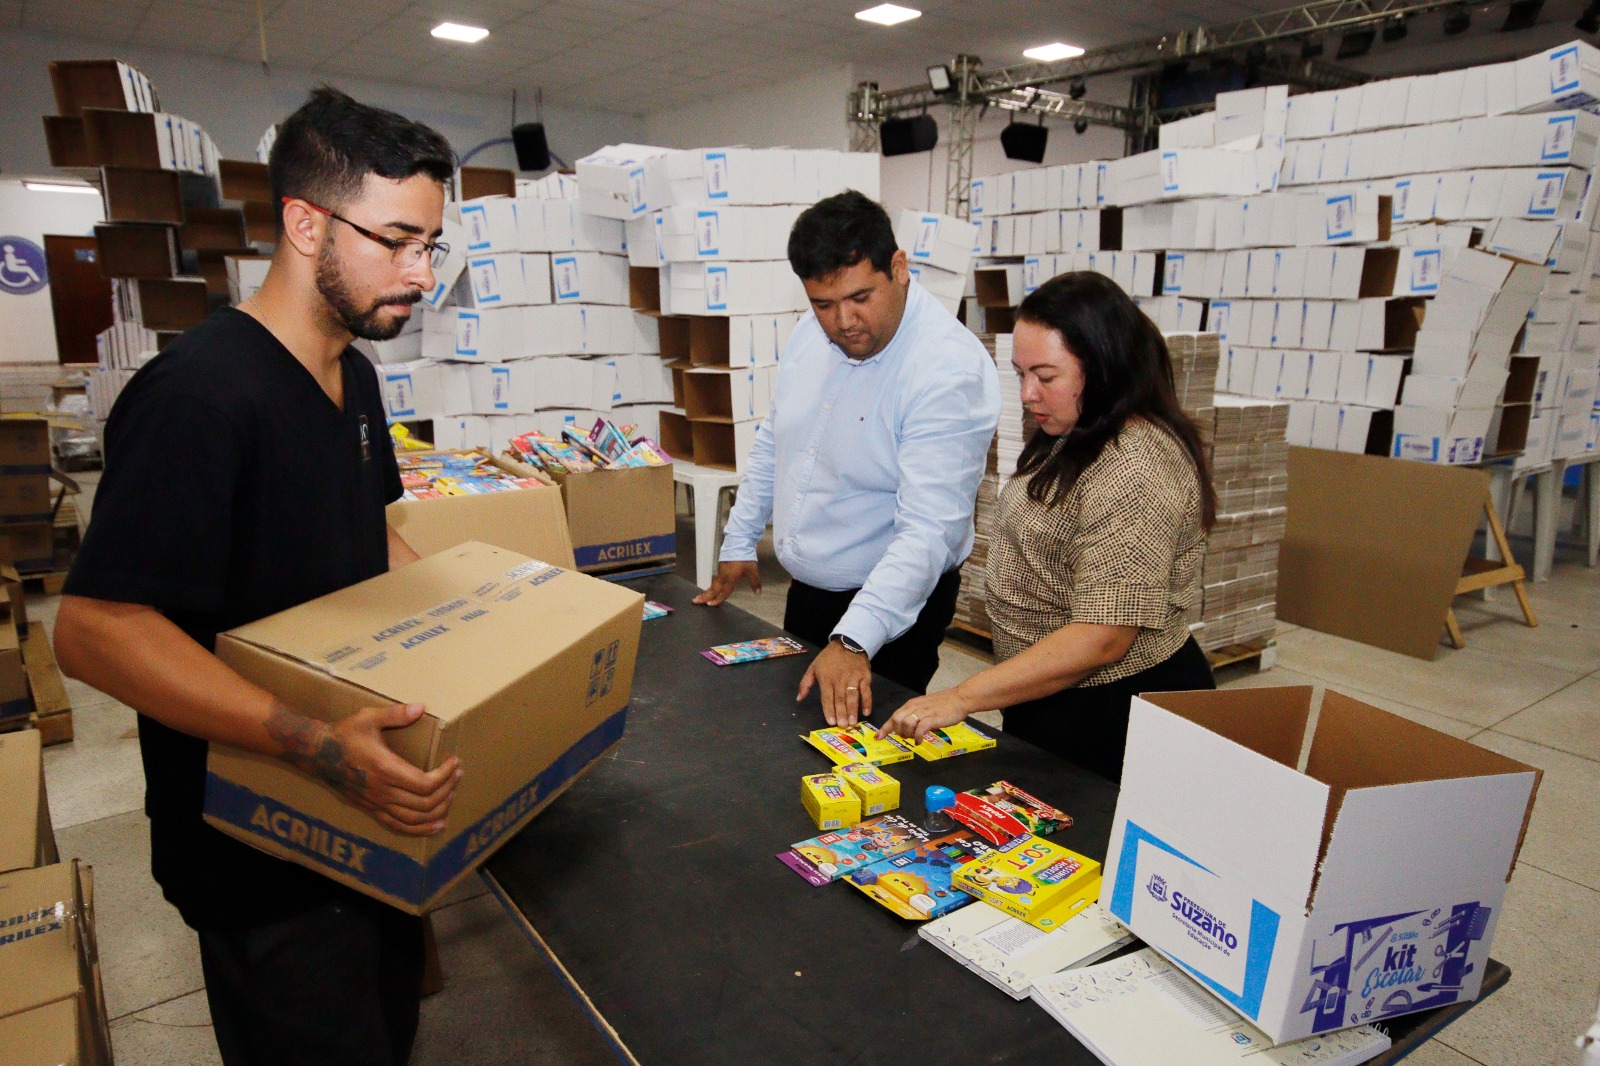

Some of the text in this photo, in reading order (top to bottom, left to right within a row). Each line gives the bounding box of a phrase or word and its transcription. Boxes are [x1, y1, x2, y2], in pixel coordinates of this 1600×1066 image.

[597, 541, 652, 561] ACRILEX
[400, 624, 450, 650] ACRILEX
[250, 803, 372, 872] ACRILEX
[1006, 843, 1052, 871] SOFT
[1170, 890, 1238, 950] Suzano
[1183, 896, 1227, 929] PREFEITURA DE
[1172, 912, 1231, 957] Secretaria Municipal de
[1187, 930, 1212, 951] Educação
[1383, 943, 1418, 973] kit
[1361, 964, 1427, 999] Escolar
